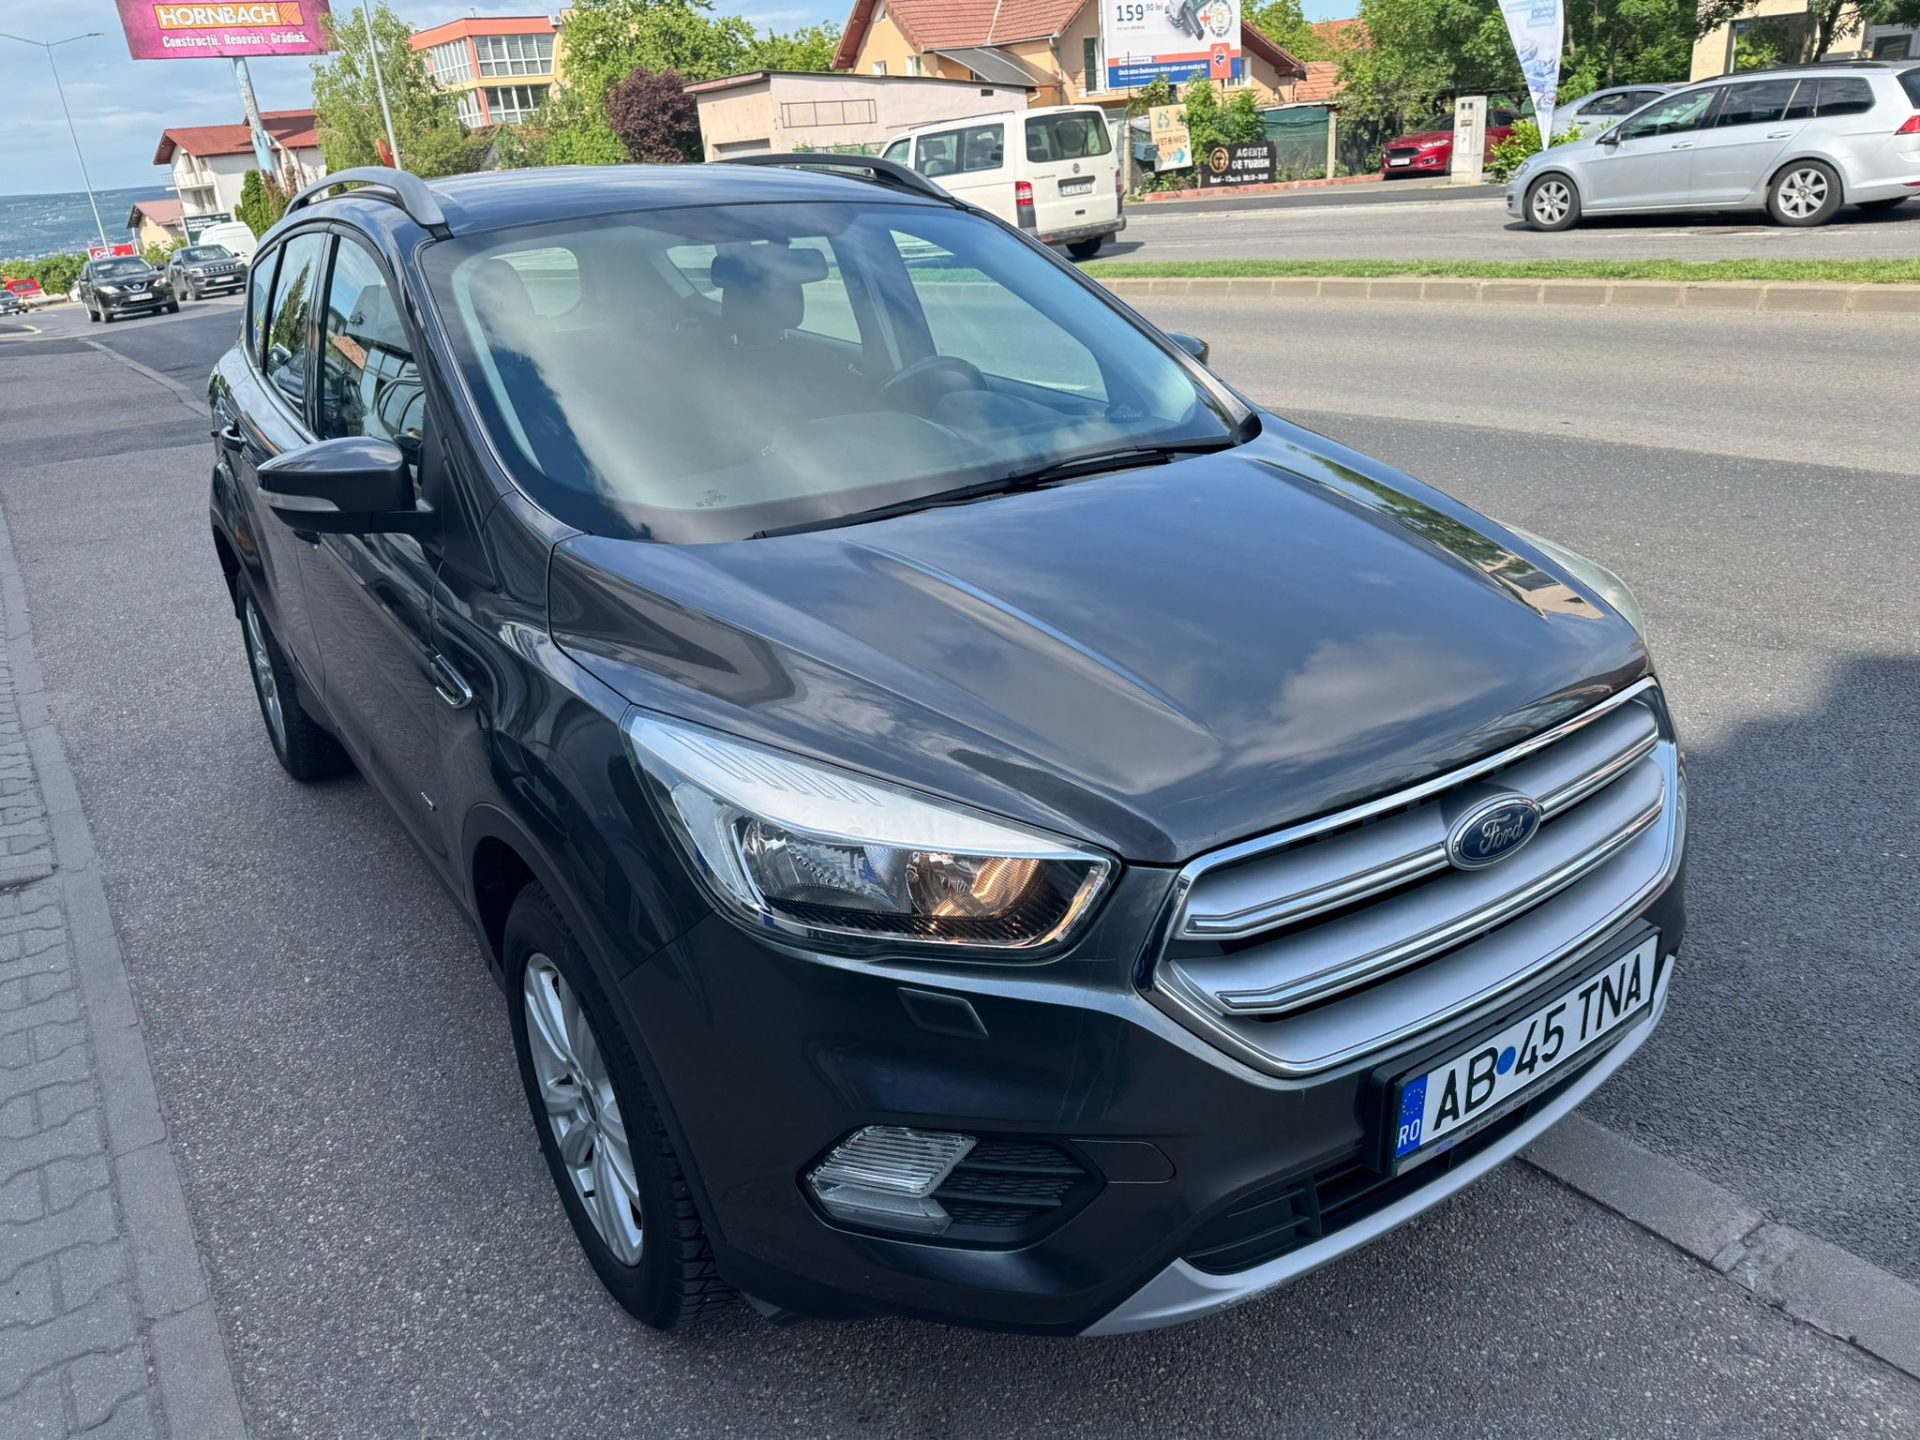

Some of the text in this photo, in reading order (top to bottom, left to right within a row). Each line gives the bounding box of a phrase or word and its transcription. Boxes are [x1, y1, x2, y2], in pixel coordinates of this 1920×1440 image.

[159, 6, 278, 26] HORNBACH
[1116, 4, 1144, 22] 159
[1480, 813, 1524, 855] Ford
[1433, 952, 1641, 1132] AB 45 TNA
[1398, 1118, 1420, 1148] RO
